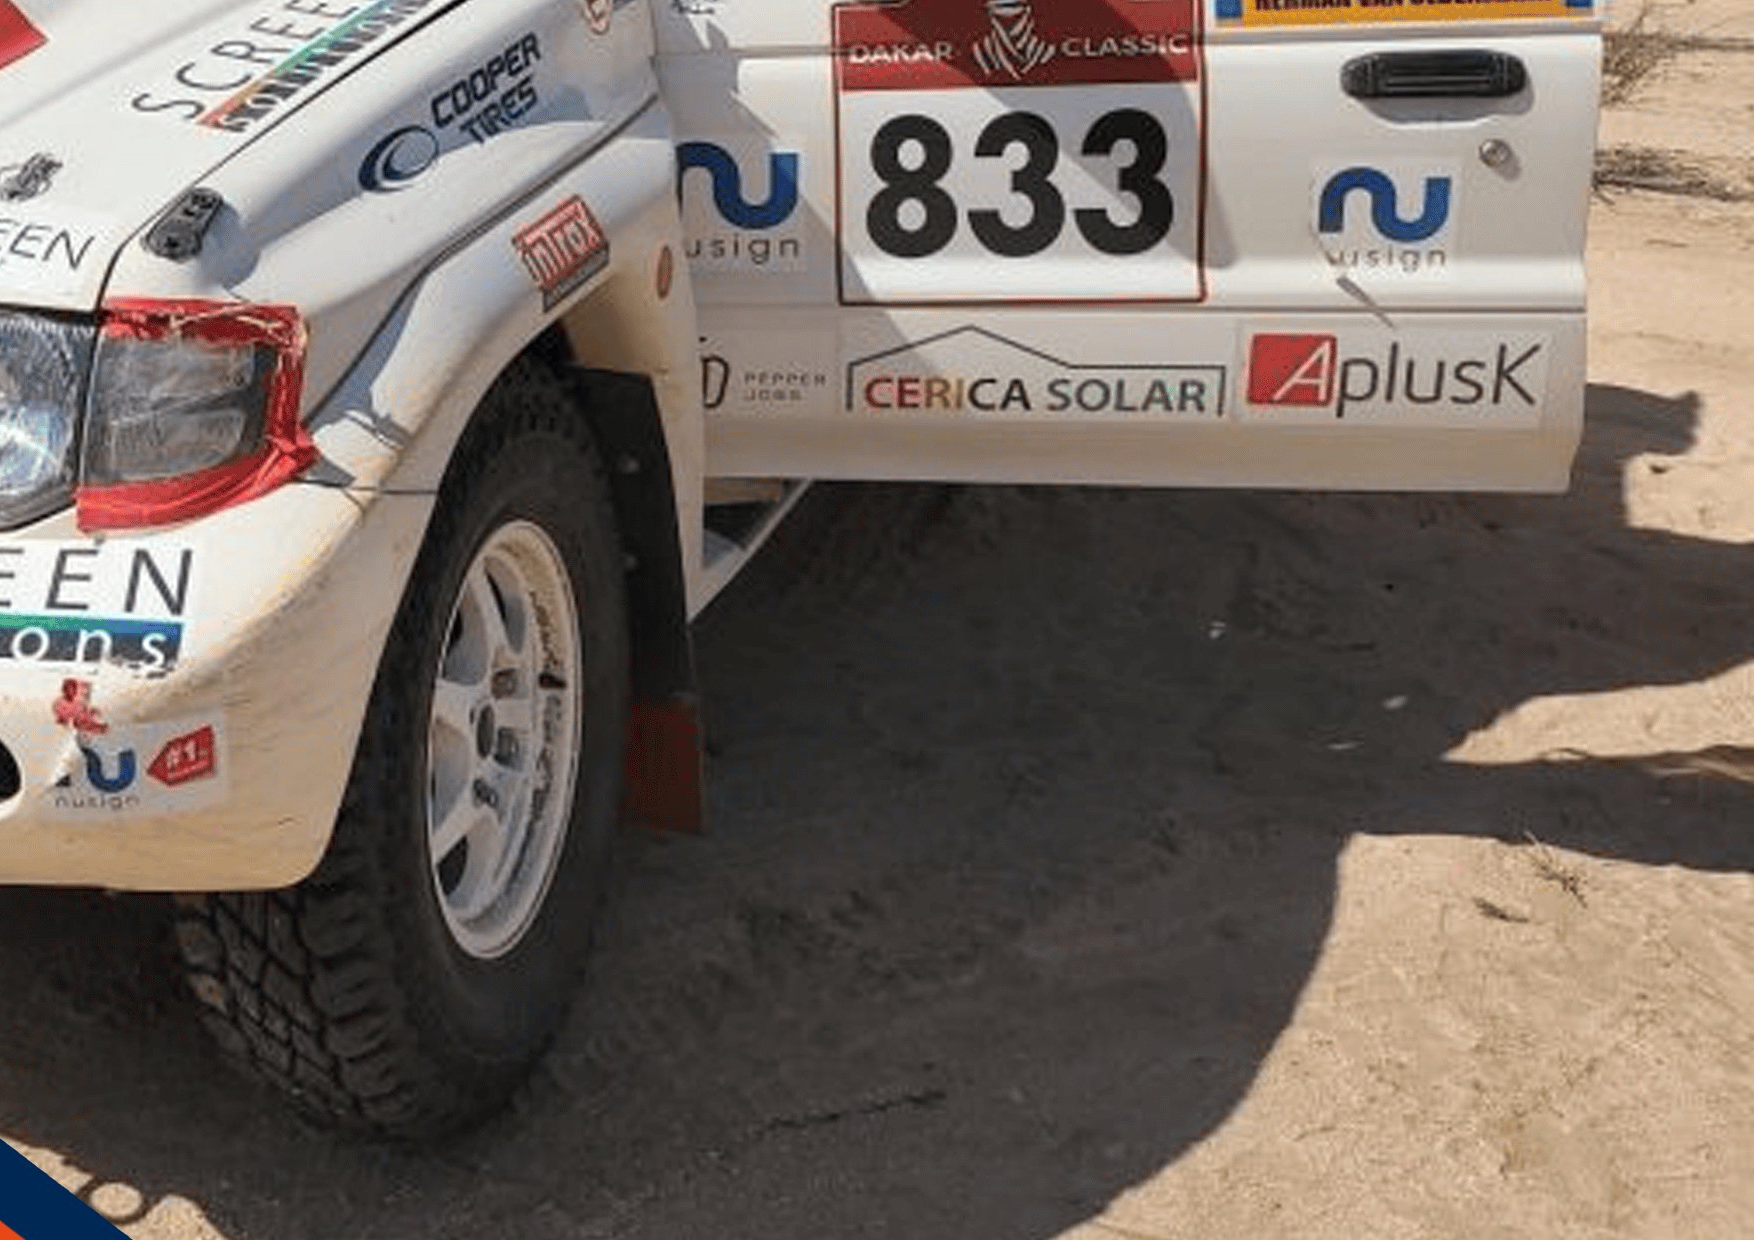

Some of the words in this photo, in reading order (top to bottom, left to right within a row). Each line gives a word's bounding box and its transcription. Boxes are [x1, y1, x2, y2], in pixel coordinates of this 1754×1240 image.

[431, 31, 542, 129] COOPER
[849, 41, 953, 64] DAKAR
[1061, 33, 1190, 58] CLASSIC
[459, 76, 539, 144] TIRES
[865, 107, 1174, 259] 833
[686, 233, 800, 265] usign
[864, 376, 1032, 412] CERICA
[1047, 378, 1207, 413] SOLAR
[1271, 338, 1543, 419] AplusK
